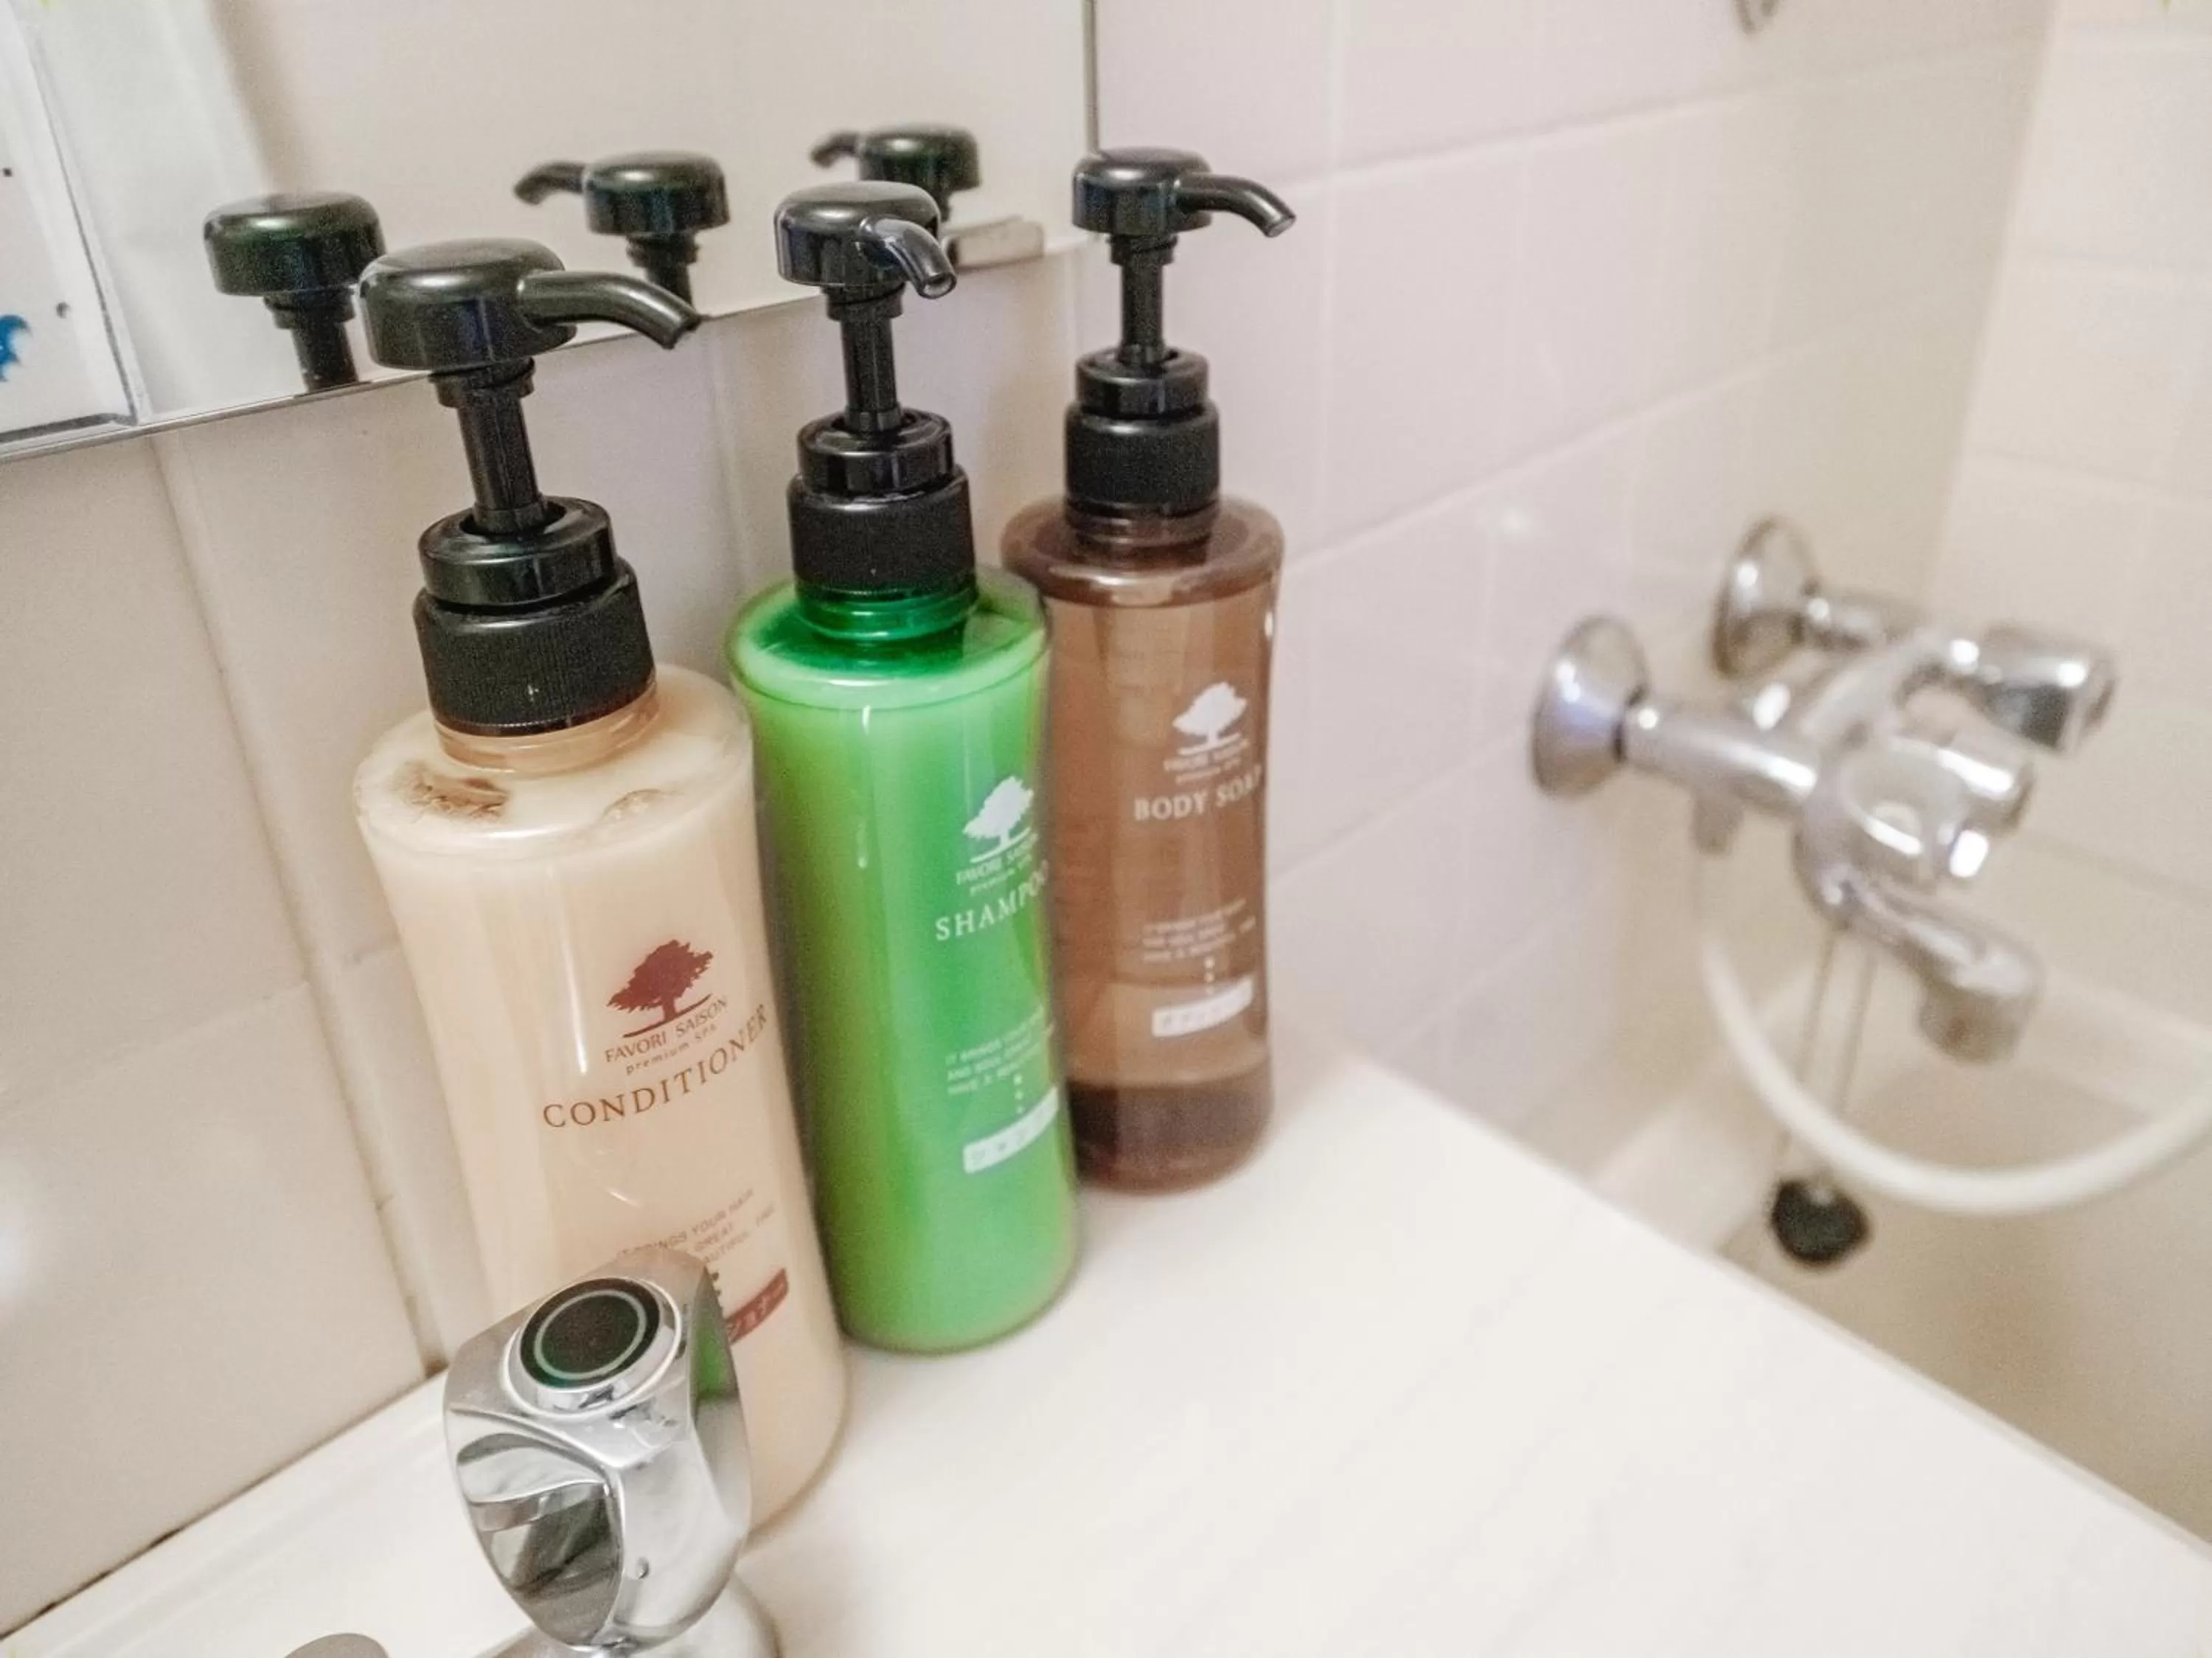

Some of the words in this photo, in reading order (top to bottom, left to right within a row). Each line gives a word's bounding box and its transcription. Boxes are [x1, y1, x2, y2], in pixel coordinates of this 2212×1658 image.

[1134, 789, 1208, 821] BODY
[605, 1030, 667, 1063] FAVORI
[675, 996, 728, 1038] SAISON
[543, 1003, 768, 1128] CONDITIONER
[626, 1041, 689, 1076] premium
